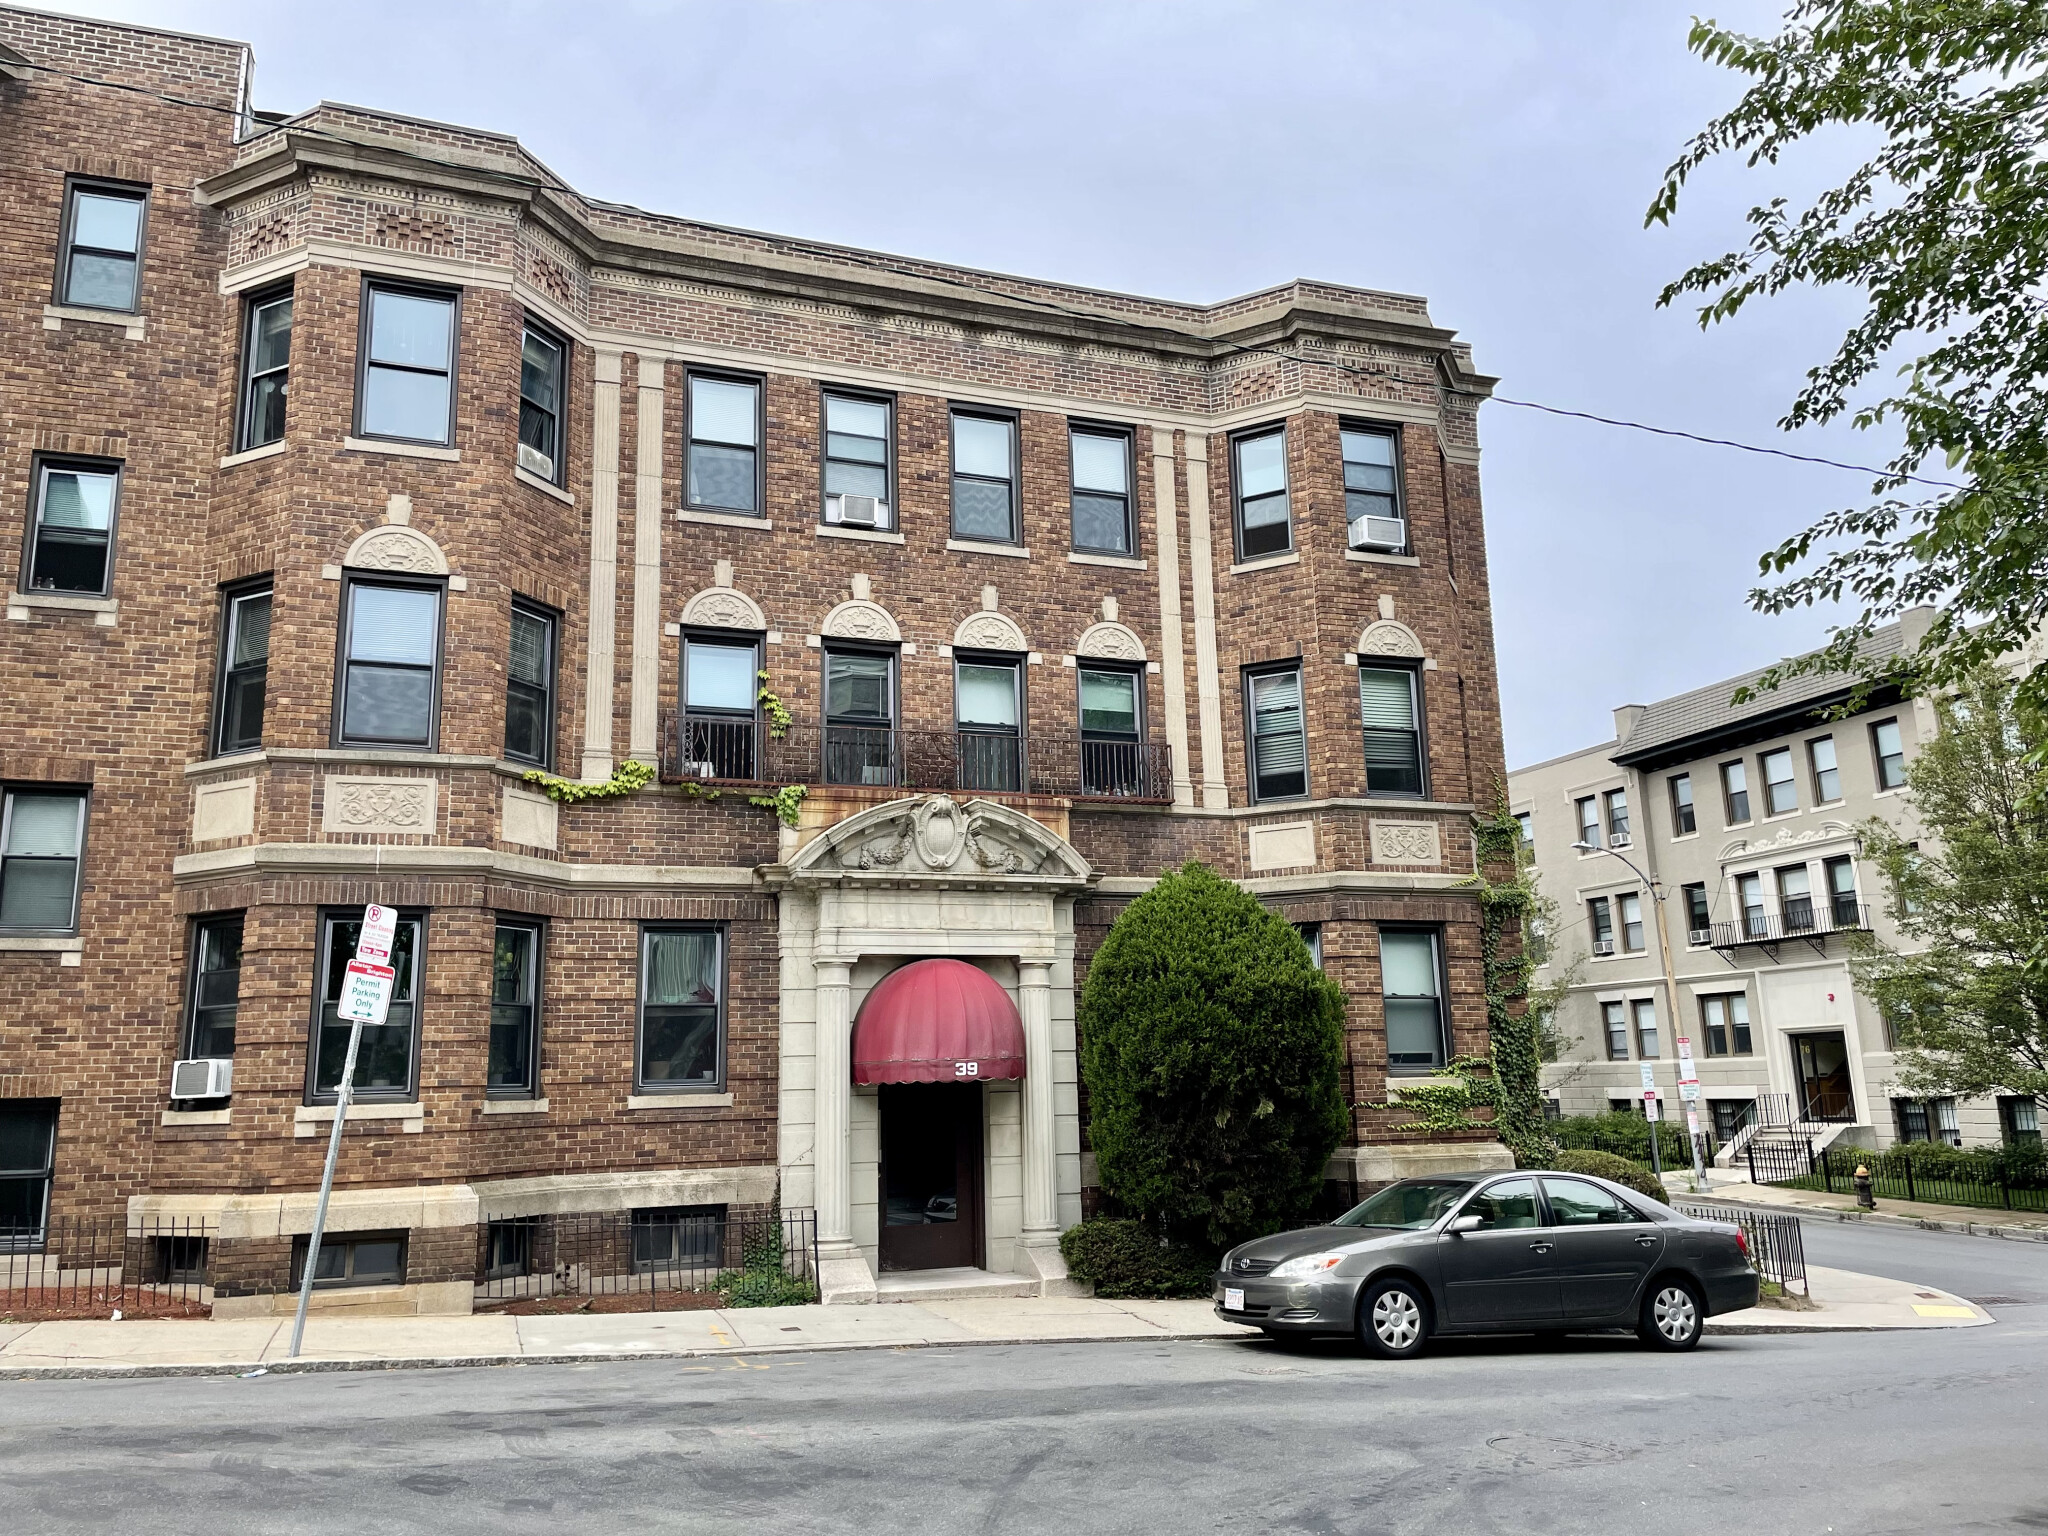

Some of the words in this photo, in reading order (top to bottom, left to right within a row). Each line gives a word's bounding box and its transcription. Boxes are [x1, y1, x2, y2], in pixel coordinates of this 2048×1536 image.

[366, 968, 393, 978] Brighton
[356, 977, 380, 988] Permit
[352, 987, 380, 1000] Parking
[355, 998, 373, 1009] Only
[955, 1062, 978, 1076] 39
